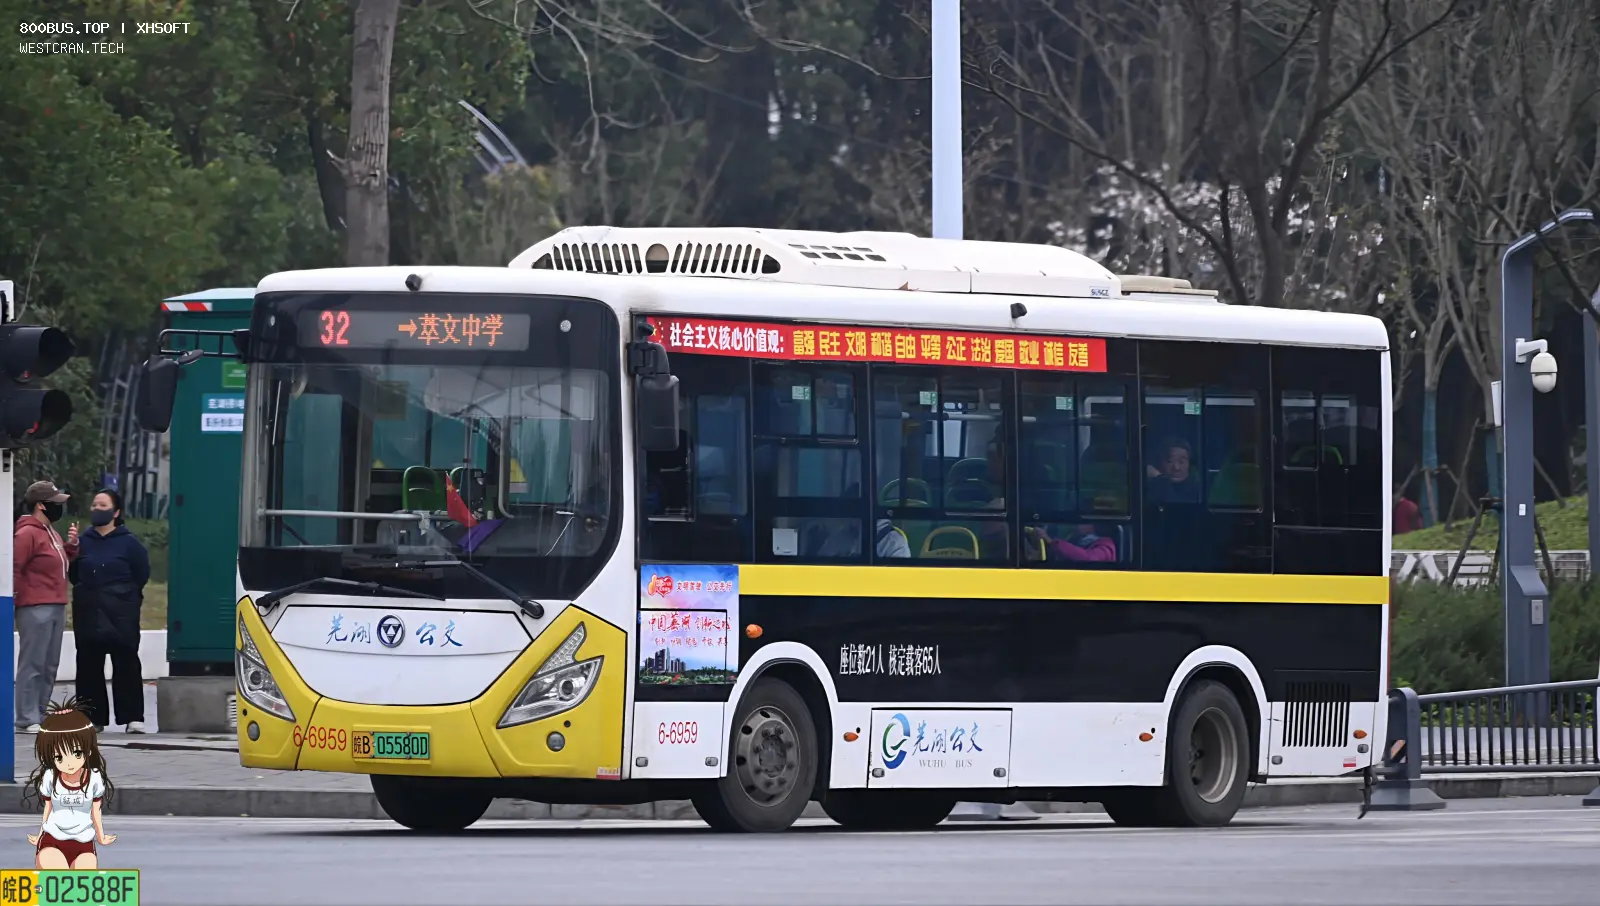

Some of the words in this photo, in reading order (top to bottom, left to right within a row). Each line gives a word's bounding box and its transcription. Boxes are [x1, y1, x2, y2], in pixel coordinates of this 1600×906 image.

[320, 310, 350, 345] 32
[417, 313, 504, 347] 萃文中学
[792, 330, 815, 356] 富强
[819, 331, 841, 356] 民主
[845, 331, 867, 357] 文明
[871, 331, 893, 357] 和谐
[895, 333, 916, 359] 自由
[920, 334, 941, 361] 平等
[946, 335, 967, 362] 公正
[971, 336, 991, 363] 法治
[1019, 340, 1040, 365] 敬业
[1043, 341, 1064, 367] 诚信
[1068, 342, 1089, 368] 友善
[415, 619, 463, 647] 公交
[839, 643, 885, 676] 座位数21人
[888, 643, 942, 676] 核定载客65人
[293, 725, 347, 751] 6-6959
[658, 721, 698, 744] 6-6959
[918, 759, 947, 768] WUHU
[955, 759, 973, 768] BUS
